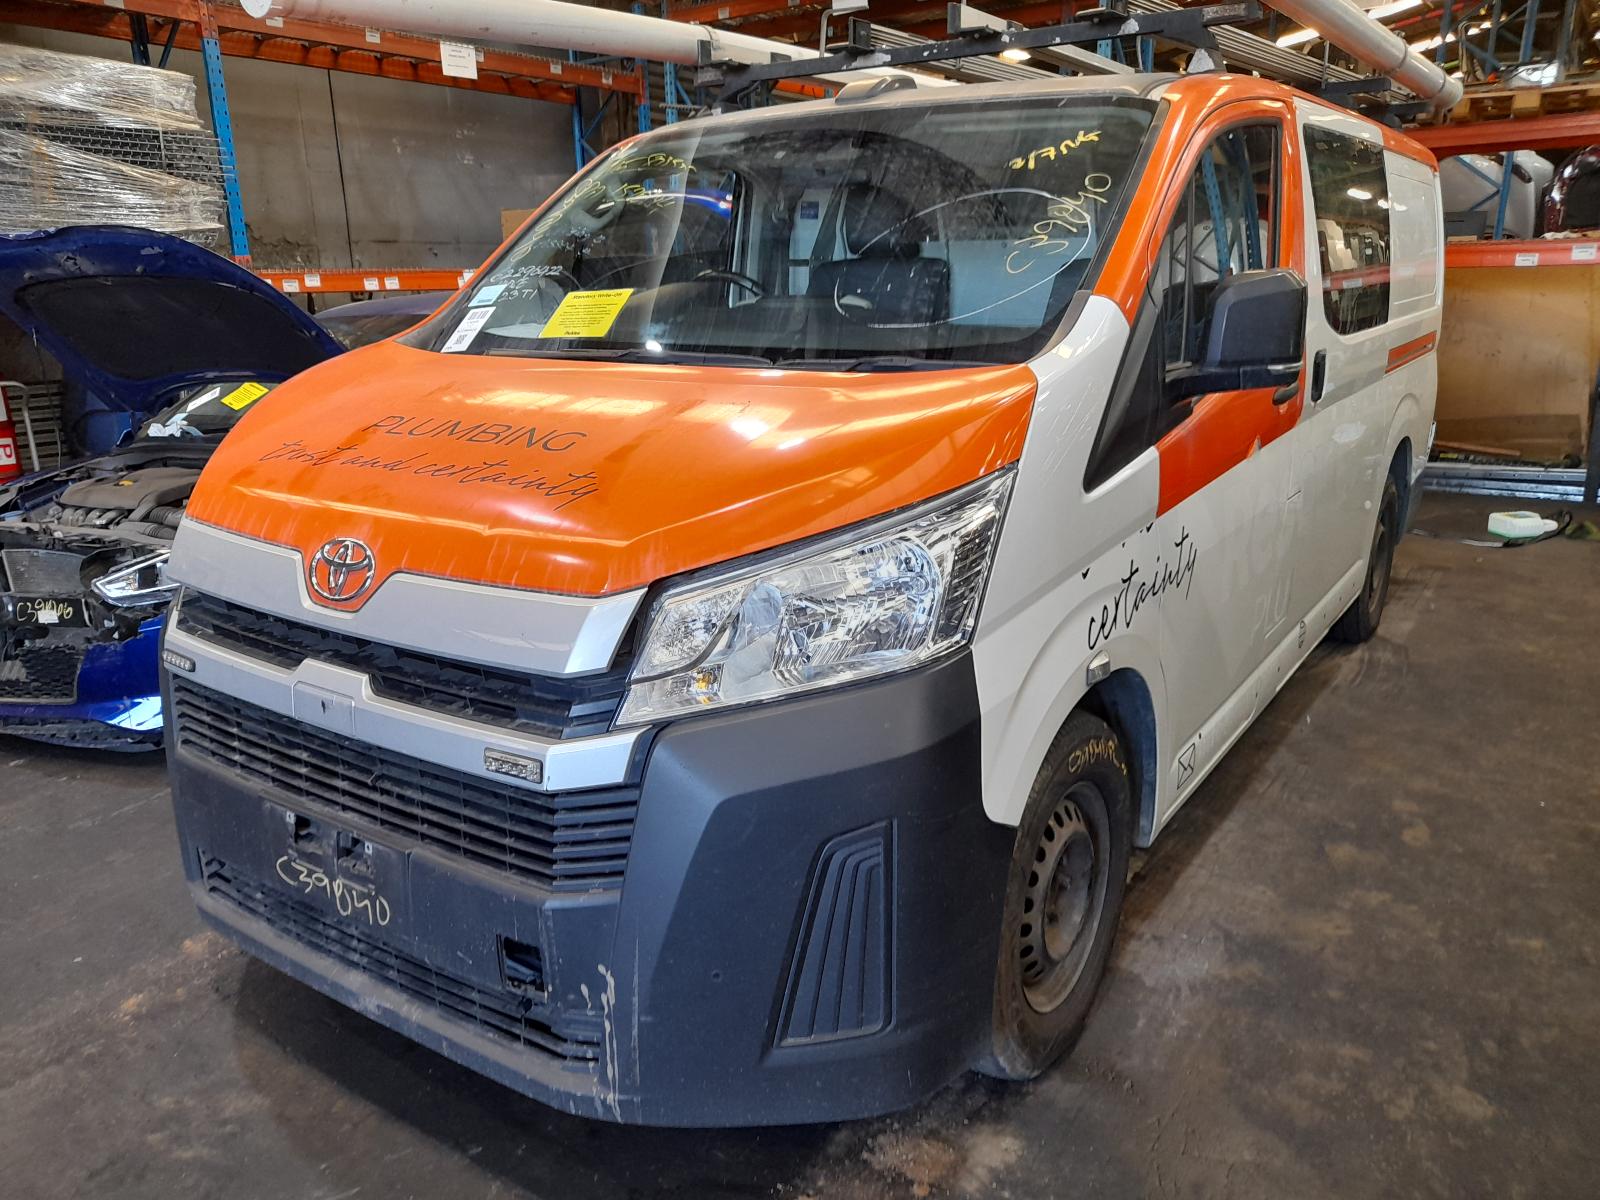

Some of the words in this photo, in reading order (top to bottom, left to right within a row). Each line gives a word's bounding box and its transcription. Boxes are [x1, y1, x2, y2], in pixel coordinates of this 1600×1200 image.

[361, 415, 587, 452] PLUMBING
[259, 440, 358, 467] trust
[342, 452, 428, 472] and
[413, 459, 600, 512] certainty
[1087, 525, 1197, 651] certainty
